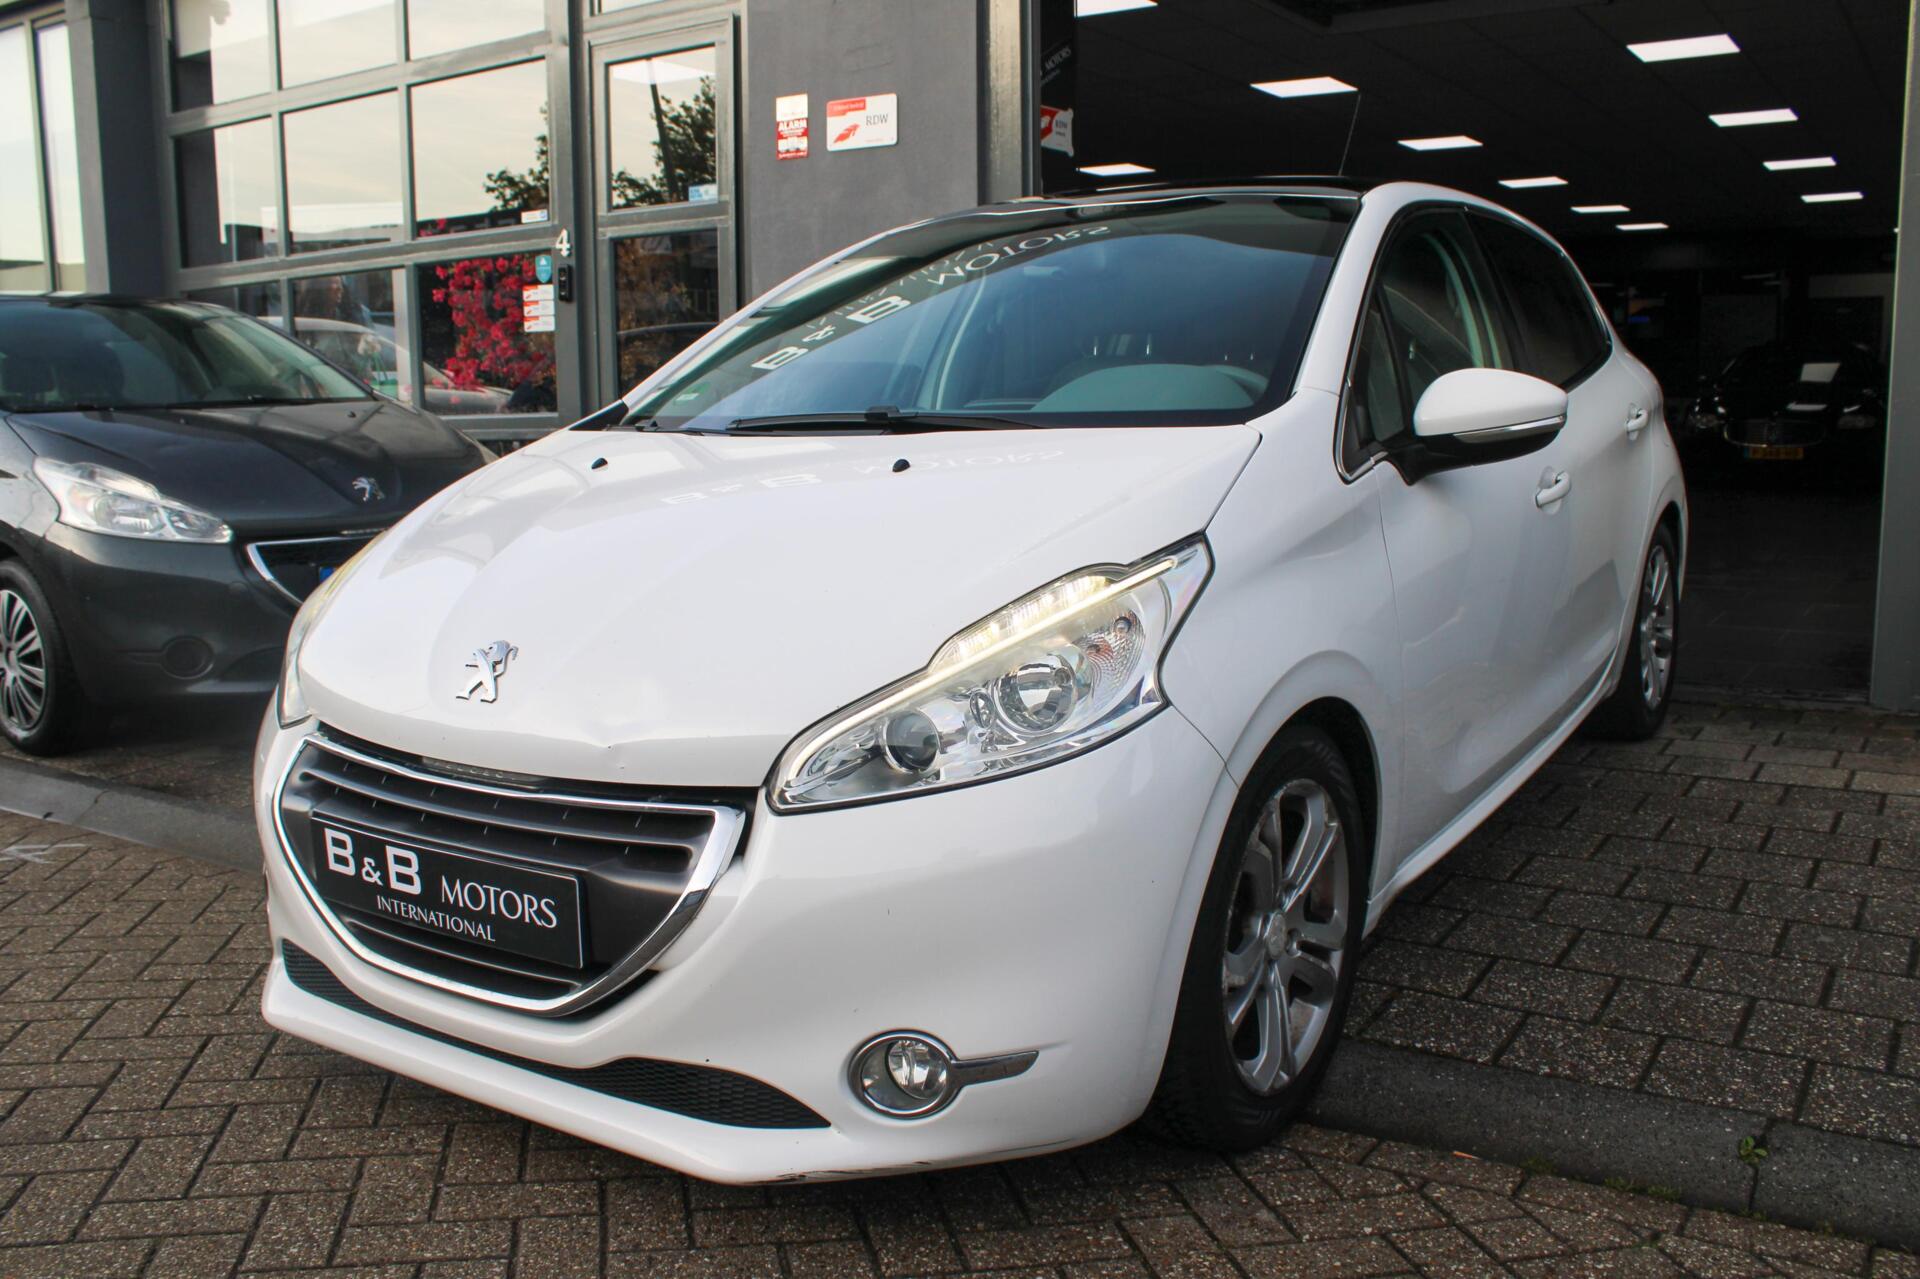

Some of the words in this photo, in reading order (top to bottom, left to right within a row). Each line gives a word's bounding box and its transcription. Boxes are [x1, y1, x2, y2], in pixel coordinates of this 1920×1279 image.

[778, 118, 808, 132] ALARM
[865, 113, 889, 126] RDW
[556, 228, 571, 257] 4
[441, 875, 557, 929] MOTORS
[376, 894, 496, 942] INTERNATIONAL
